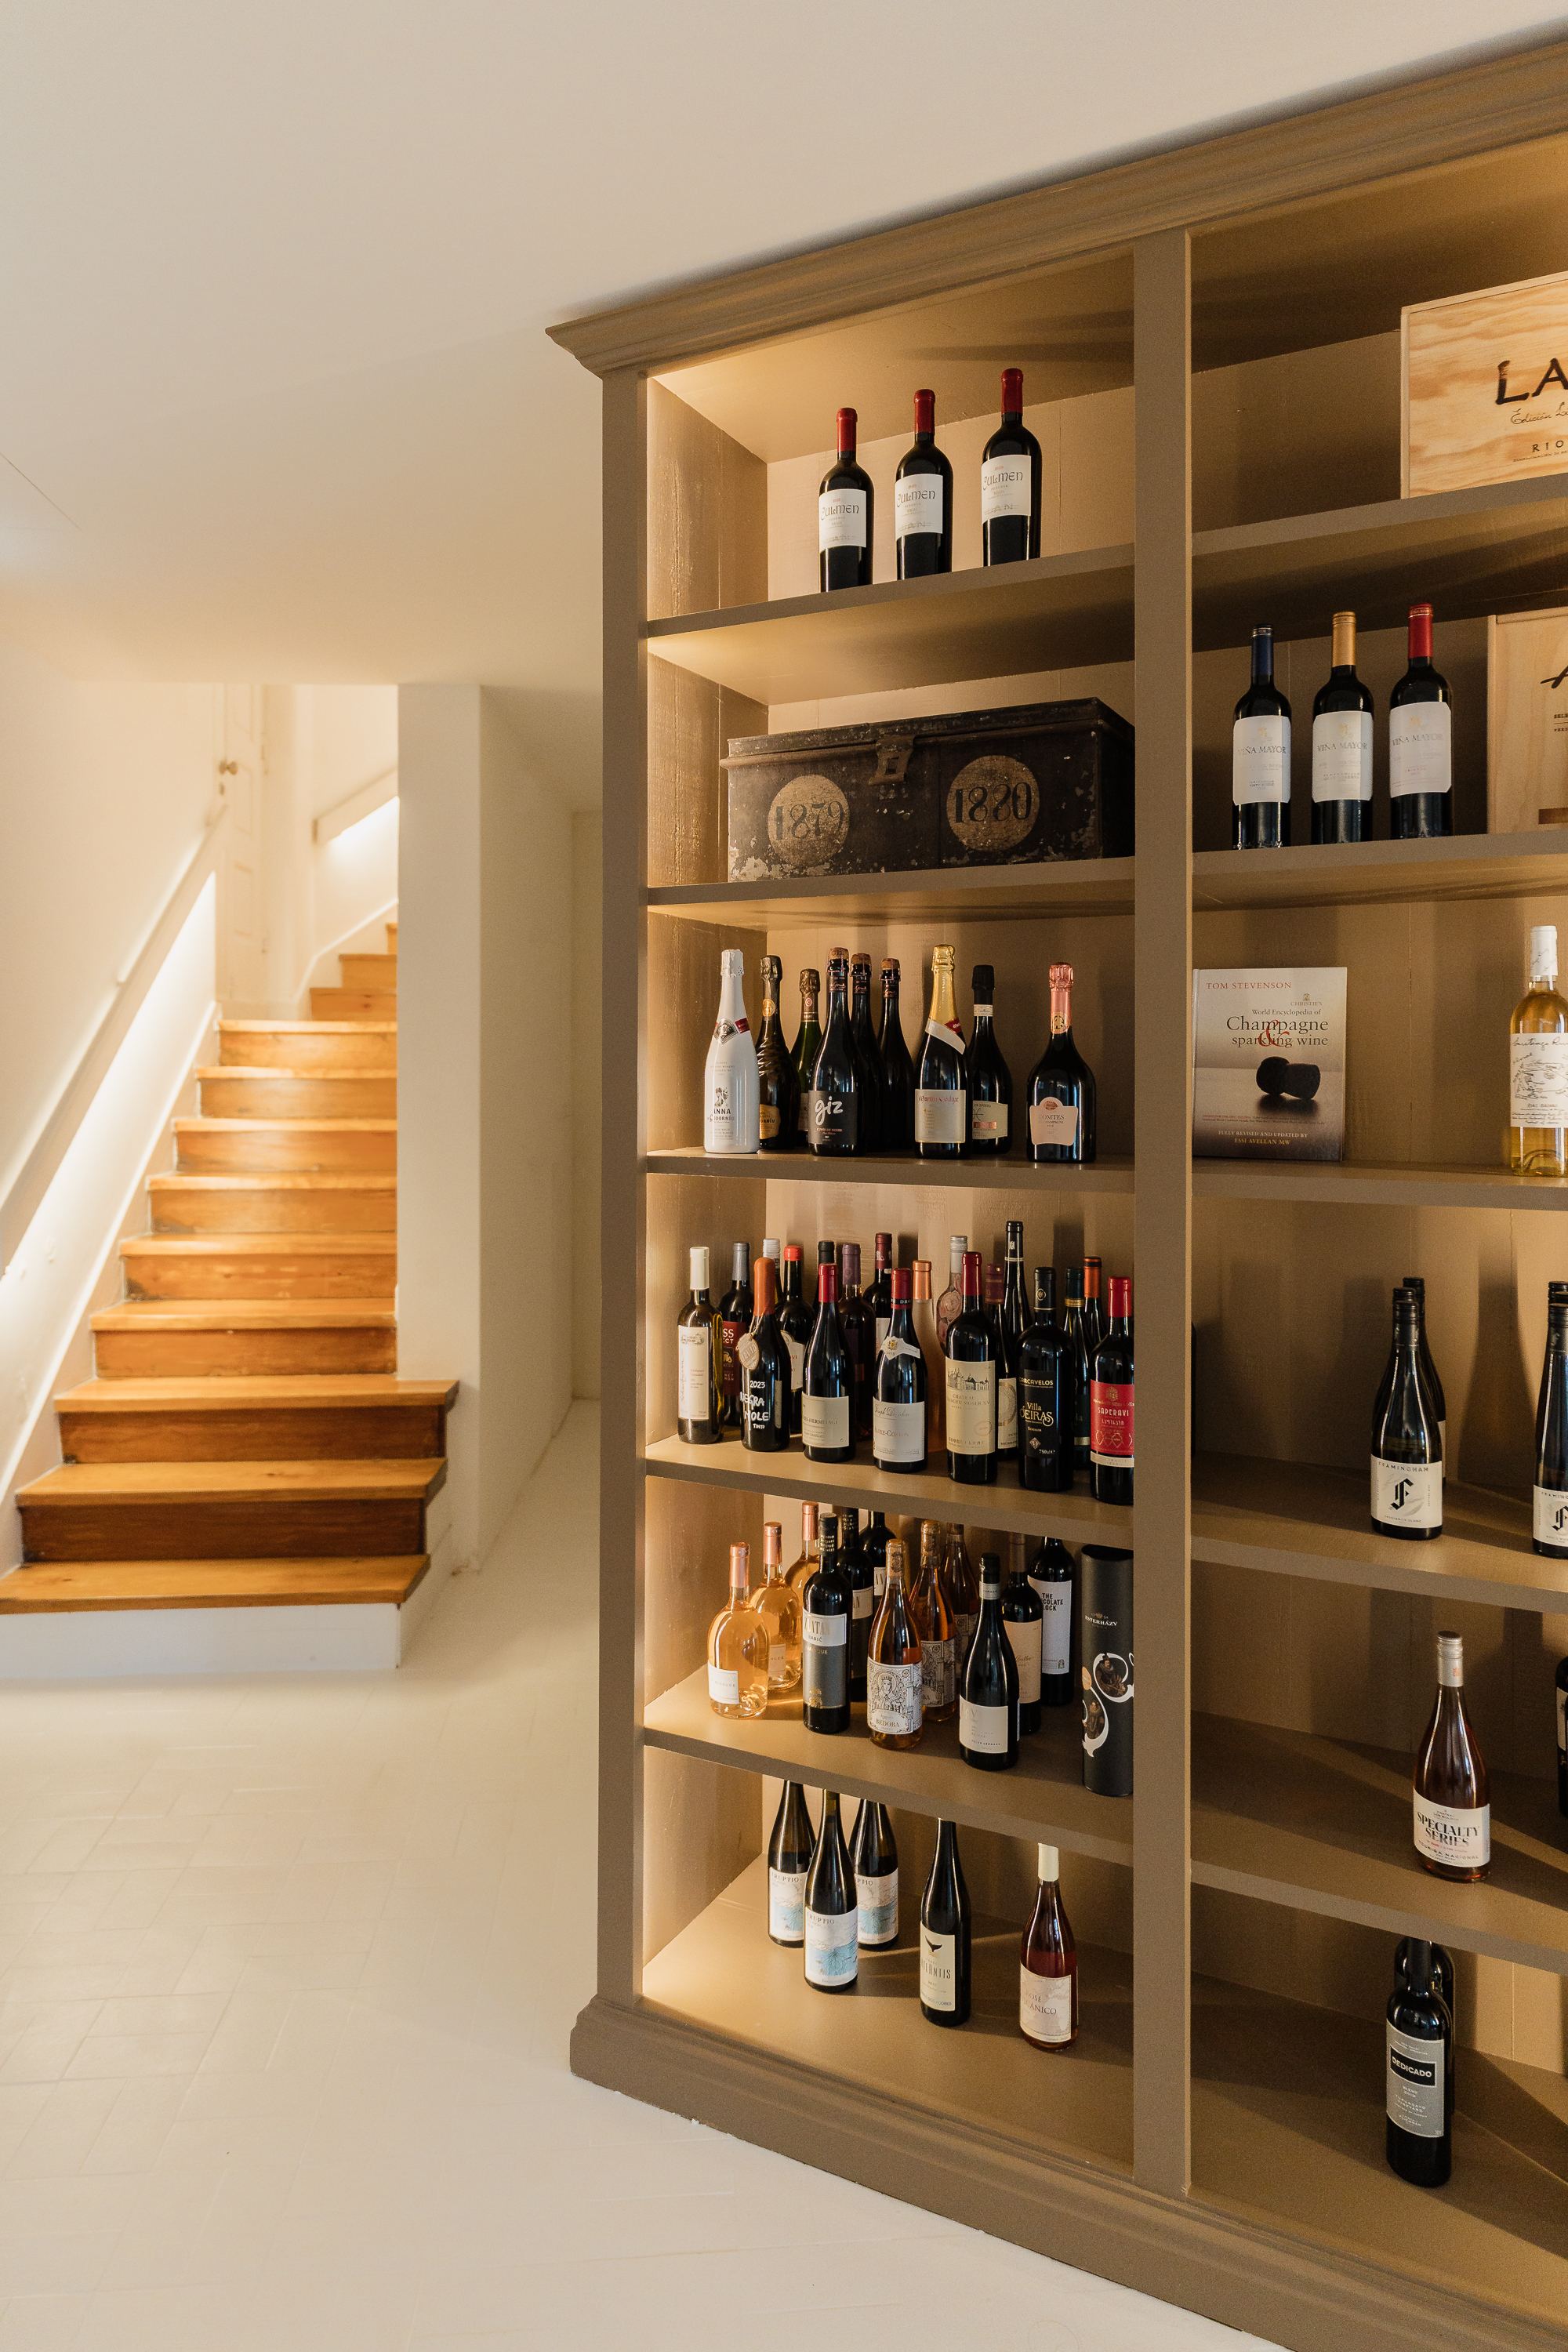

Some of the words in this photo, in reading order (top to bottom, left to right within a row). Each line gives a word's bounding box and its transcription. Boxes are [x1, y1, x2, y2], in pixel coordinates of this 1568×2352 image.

[1259, 745, 1287, 753] MAYOR
[954, 782, 1032, 823] 1880
[775, 800, 845, 840] 1879
[1226, 1015, 1328, 1034] Champagne
[1232, 1033, 1293, 1048] sparkling
[1297, 1034, 1328, 1045] wine
[815, 1095, 843, 1126] giz
[750, 1380, 766, 1388] 2023
[1026, 1402, 1042, 1411] Villa
[1098, 1406, 1130, 1417] SAPERAVI
[744, 1410, 769, 1421] MOLE
[1378, 1461, 1429, 1472] FRAMINGHAM
[1417, 1811, 1478, 1837] SPECIALTY
[1425, 1828, 1470, 1848] SERIES
[856, 1877, 873, 1886] PTIO
[1392, 2056, 1432, 2078] DEDICADO
